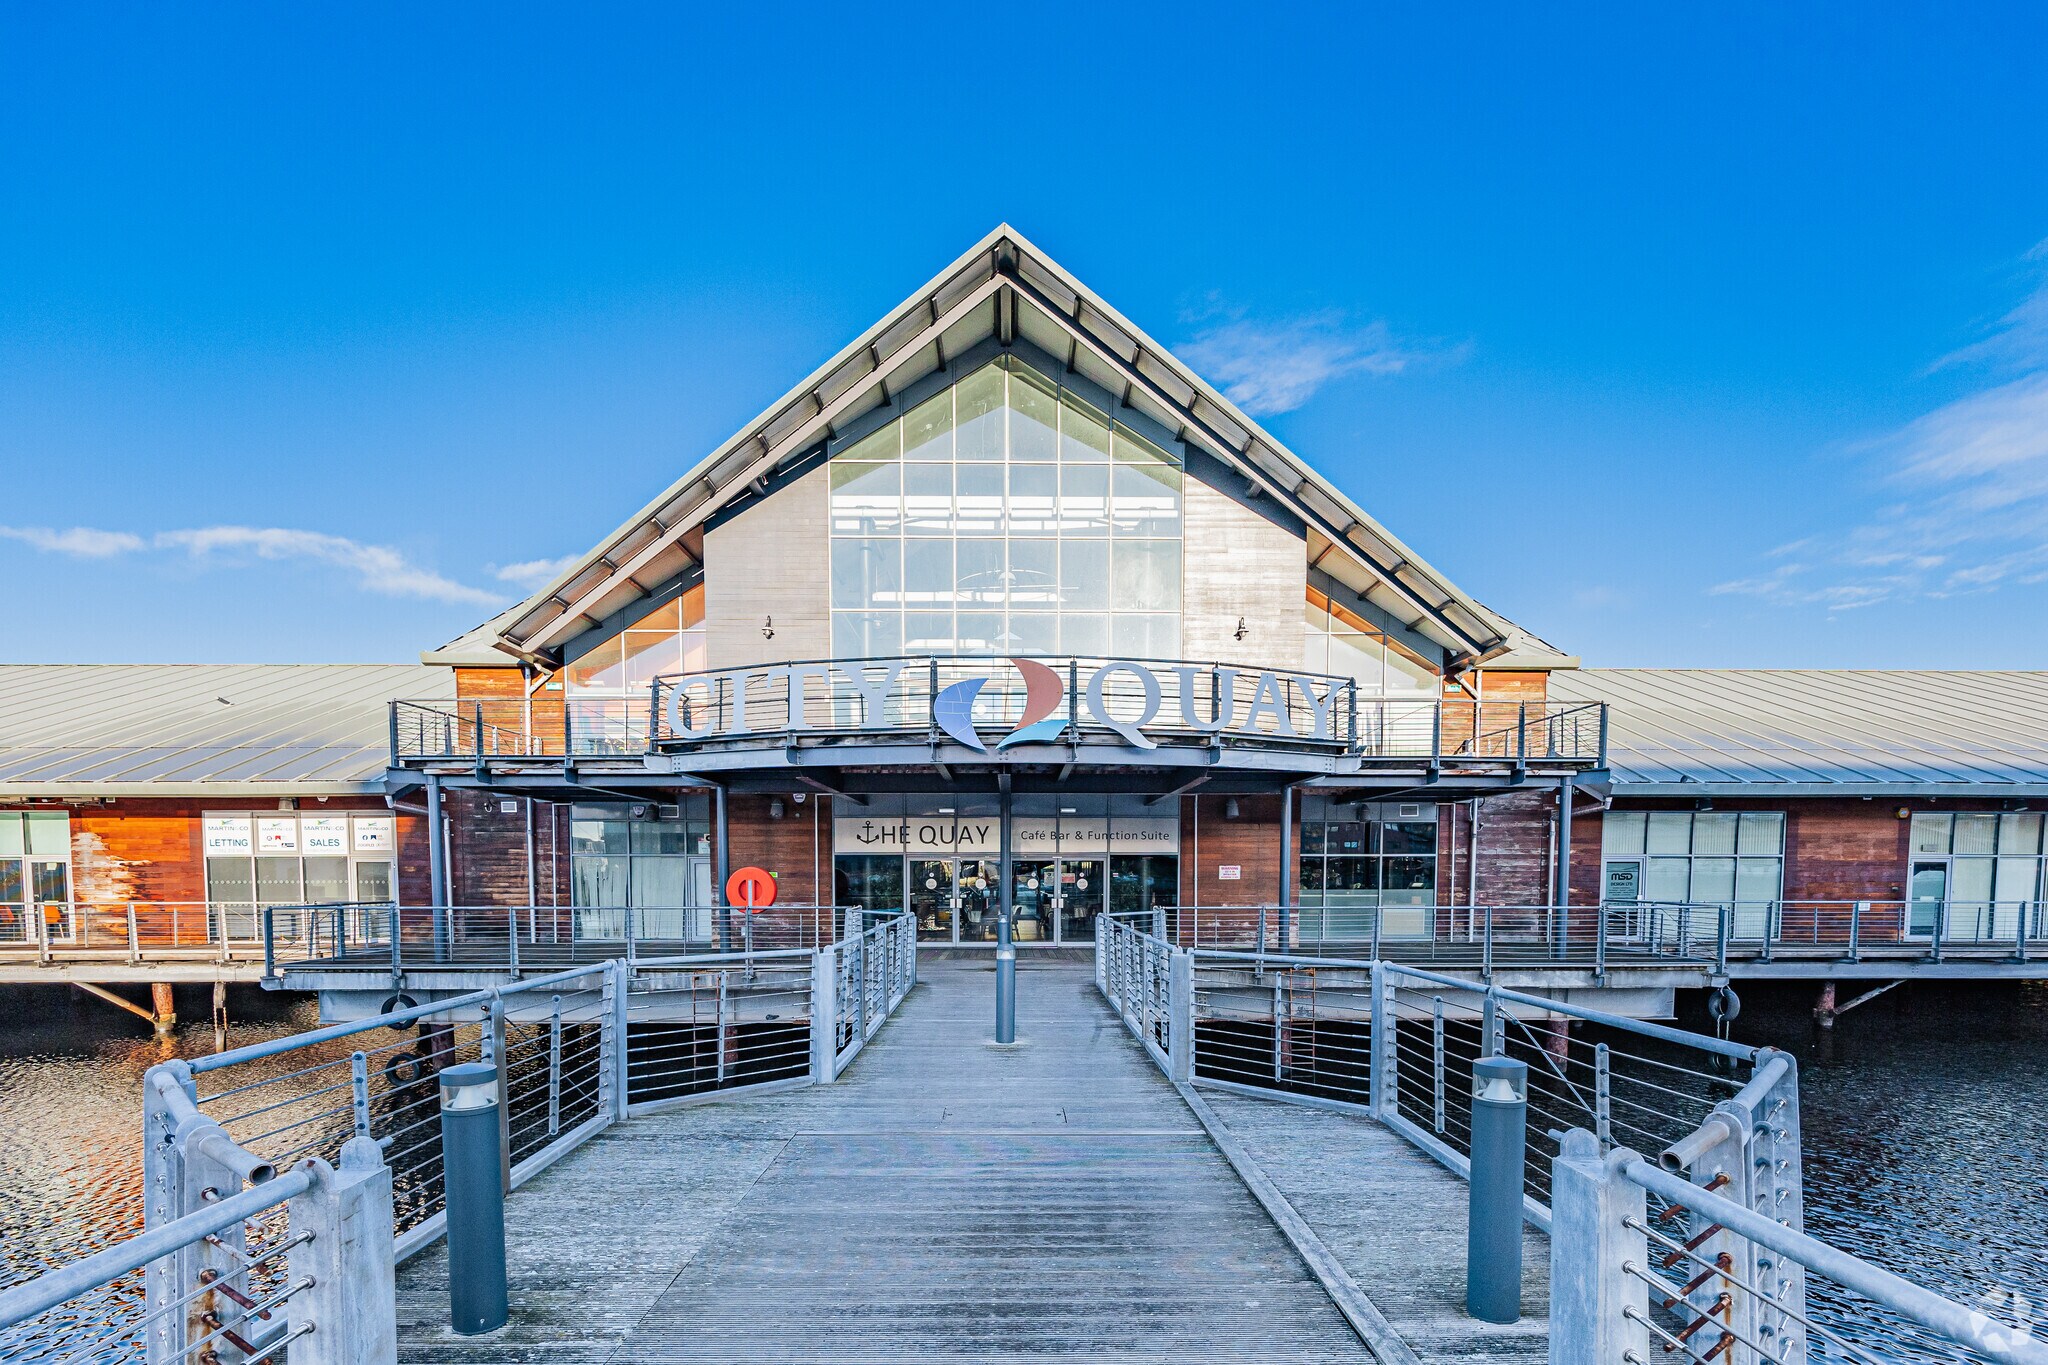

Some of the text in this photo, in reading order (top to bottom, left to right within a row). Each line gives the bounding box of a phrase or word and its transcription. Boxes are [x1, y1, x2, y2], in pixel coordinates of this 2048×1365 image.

[667, 661, 1348, 749] CITY QUAY
[919, 825, 989, 846] QUAY
[1020, 830, 1170, 840] Café Bar & Function Suite
[209, 839, 248, 847] LETTING
[310, 839, 340, 847] SALES
